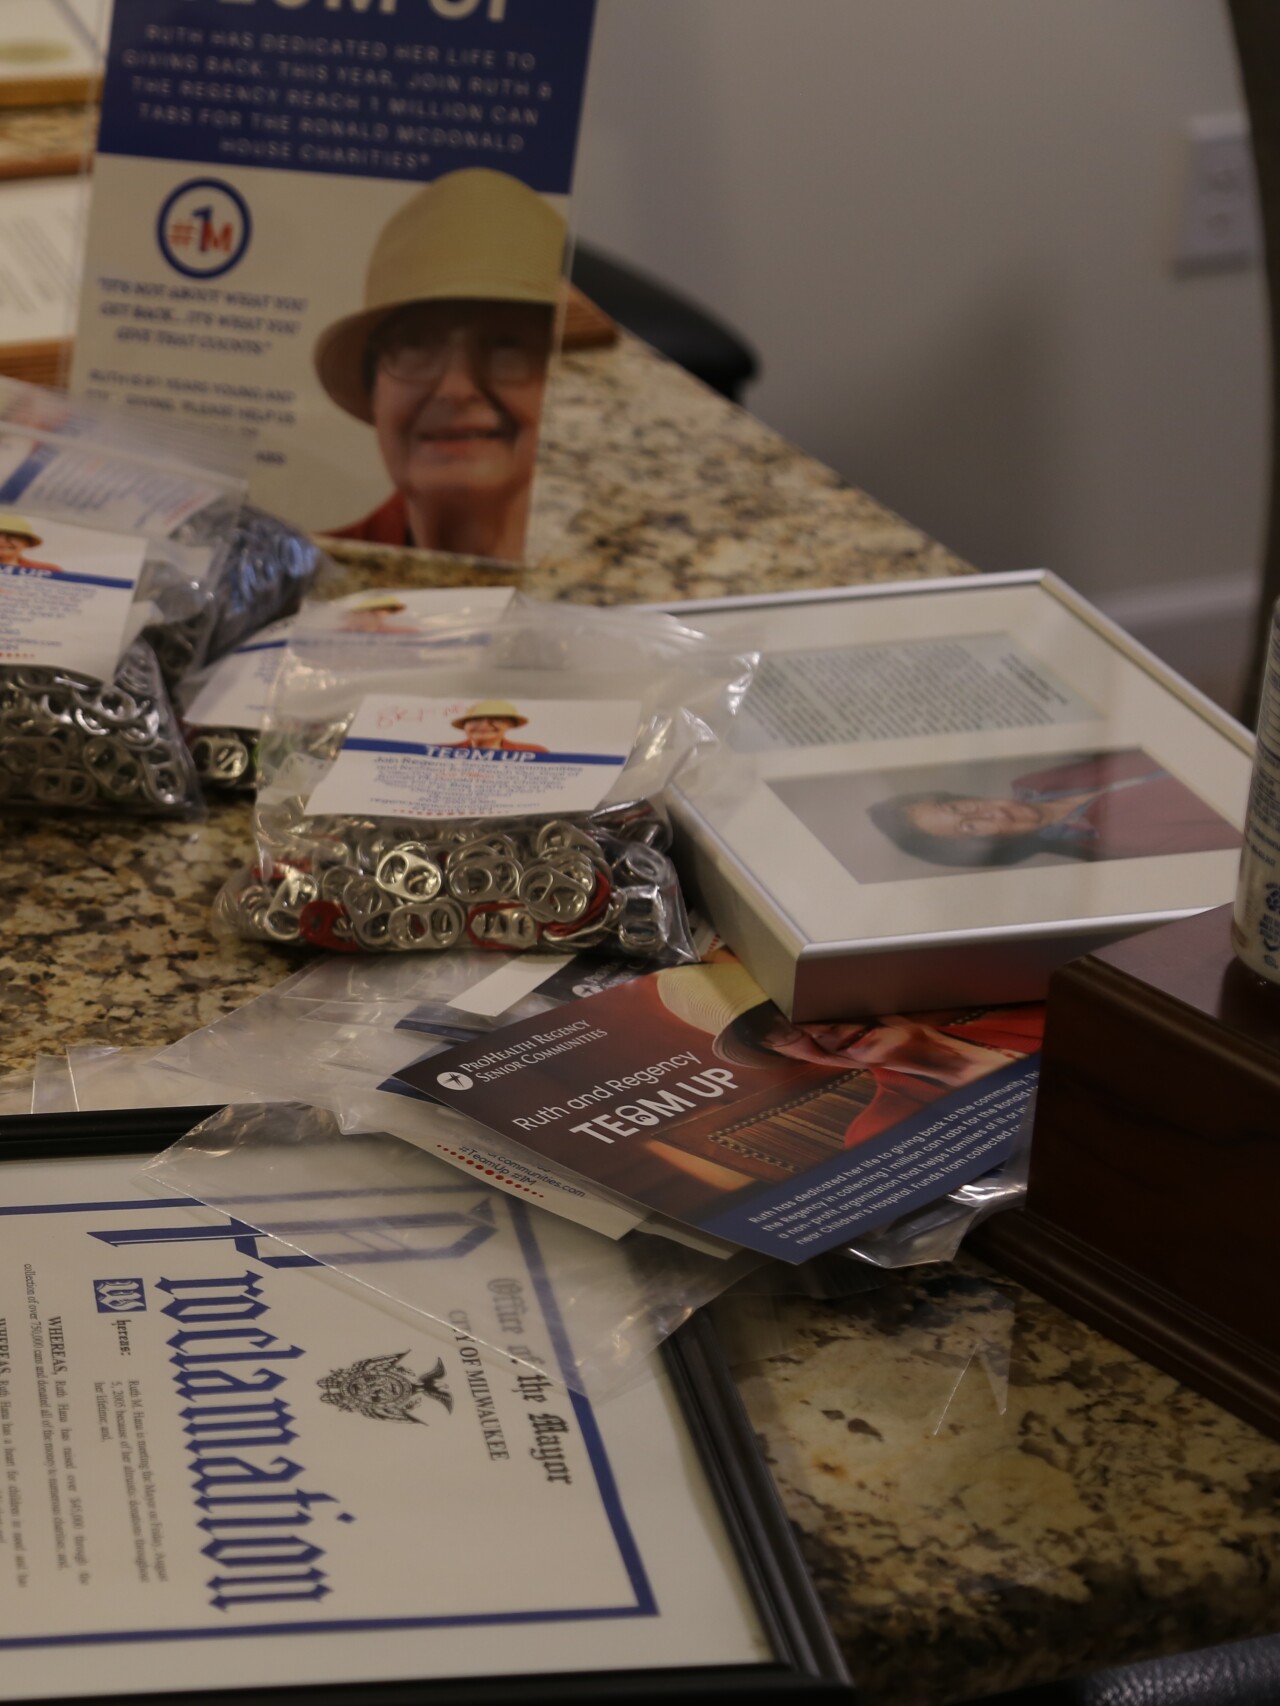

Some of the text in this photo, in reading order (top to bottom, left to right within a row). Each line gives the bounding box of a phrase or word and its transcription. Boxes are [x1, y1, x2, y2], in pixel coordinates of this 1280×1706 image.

[119, 48, 198, 73] GIVING
[276, 60, 330, 82] THIS
[404, 71, 462, 93] JOIN
[467, 75, 531, 97] RUTH
[142, 22, 536, 71] RUTH HAS DEDICATED HER LIFE TO
[129, 75, 172, 96] THE
[178, 79, 279, 105] REGENCY
[284, 88, 360, 112] REACH
[386, 96, 484, 121] MILLION
[488, 104, 538, 126] CAN
[137, 102, 525, 152] TABS FOR THE RONALD MCDONALD
[217, 136, 293, 159] HOUSE
[18, 566, 52, 577] UP
[423, 744, 537, 762] TEAM UP
[512, 1051, 702, 1131] Ruth and Regency
[568, 1067, 740, 1145] TEAM UP
[459, 1145, 537, 1186] #TeamUp #1M
[748, 1211, 777, 1223] Ruth
[772, 1201, 797, 1212] has
[795, 1175, 847, 1202] dedicated
[842, 1167, 864, 1177] her
[860, 1159, 881, 1168] life
[891, 1136, 925, 1154] giving
[918, 1121, 947, 1137] back
[955, 1105, 975, 1115] the
[762, 1222, 784, 1231] the
[780, 1201, 828, 1223] Regency
[836, 1171, 889, 1197] collecting
[889, 1151, 925, 1169] million
[922, 1139, 944, 1151] can
[940, 1126, 967, 1140] tabs
[962, 1117, 980, 1126] for
[977, 1108, 998, 1118] the
[993, 1091, 1030, 1109] Ronald
[796, 1232, 822, 1245] near
[820, 1209, 873, 1233] Children's
[910, 1172, 944, 1189] Funds
[940, 1159, 968, 1173] from
[966, 1130, 1012, 1159] collected
[839, 1179, 902, 1210] organization
[897, 1167, 923, 1180] that
[918, 1153, 950, 1169] helps
[945, 1130, 988, 1153] families
[985, 1122, 998, 1130] of
[488, 1278, 527, 1334] Office
[48, 1316, 66, 1375] WHEREAS,
[87, 1197, 499, 1613] Proclamation
[449, 1310, 509, 1460] CITY OF MILWAUKEE
[512, 1374, 553, 1403] the
[528, 1413, 572, 1485] Mayor
